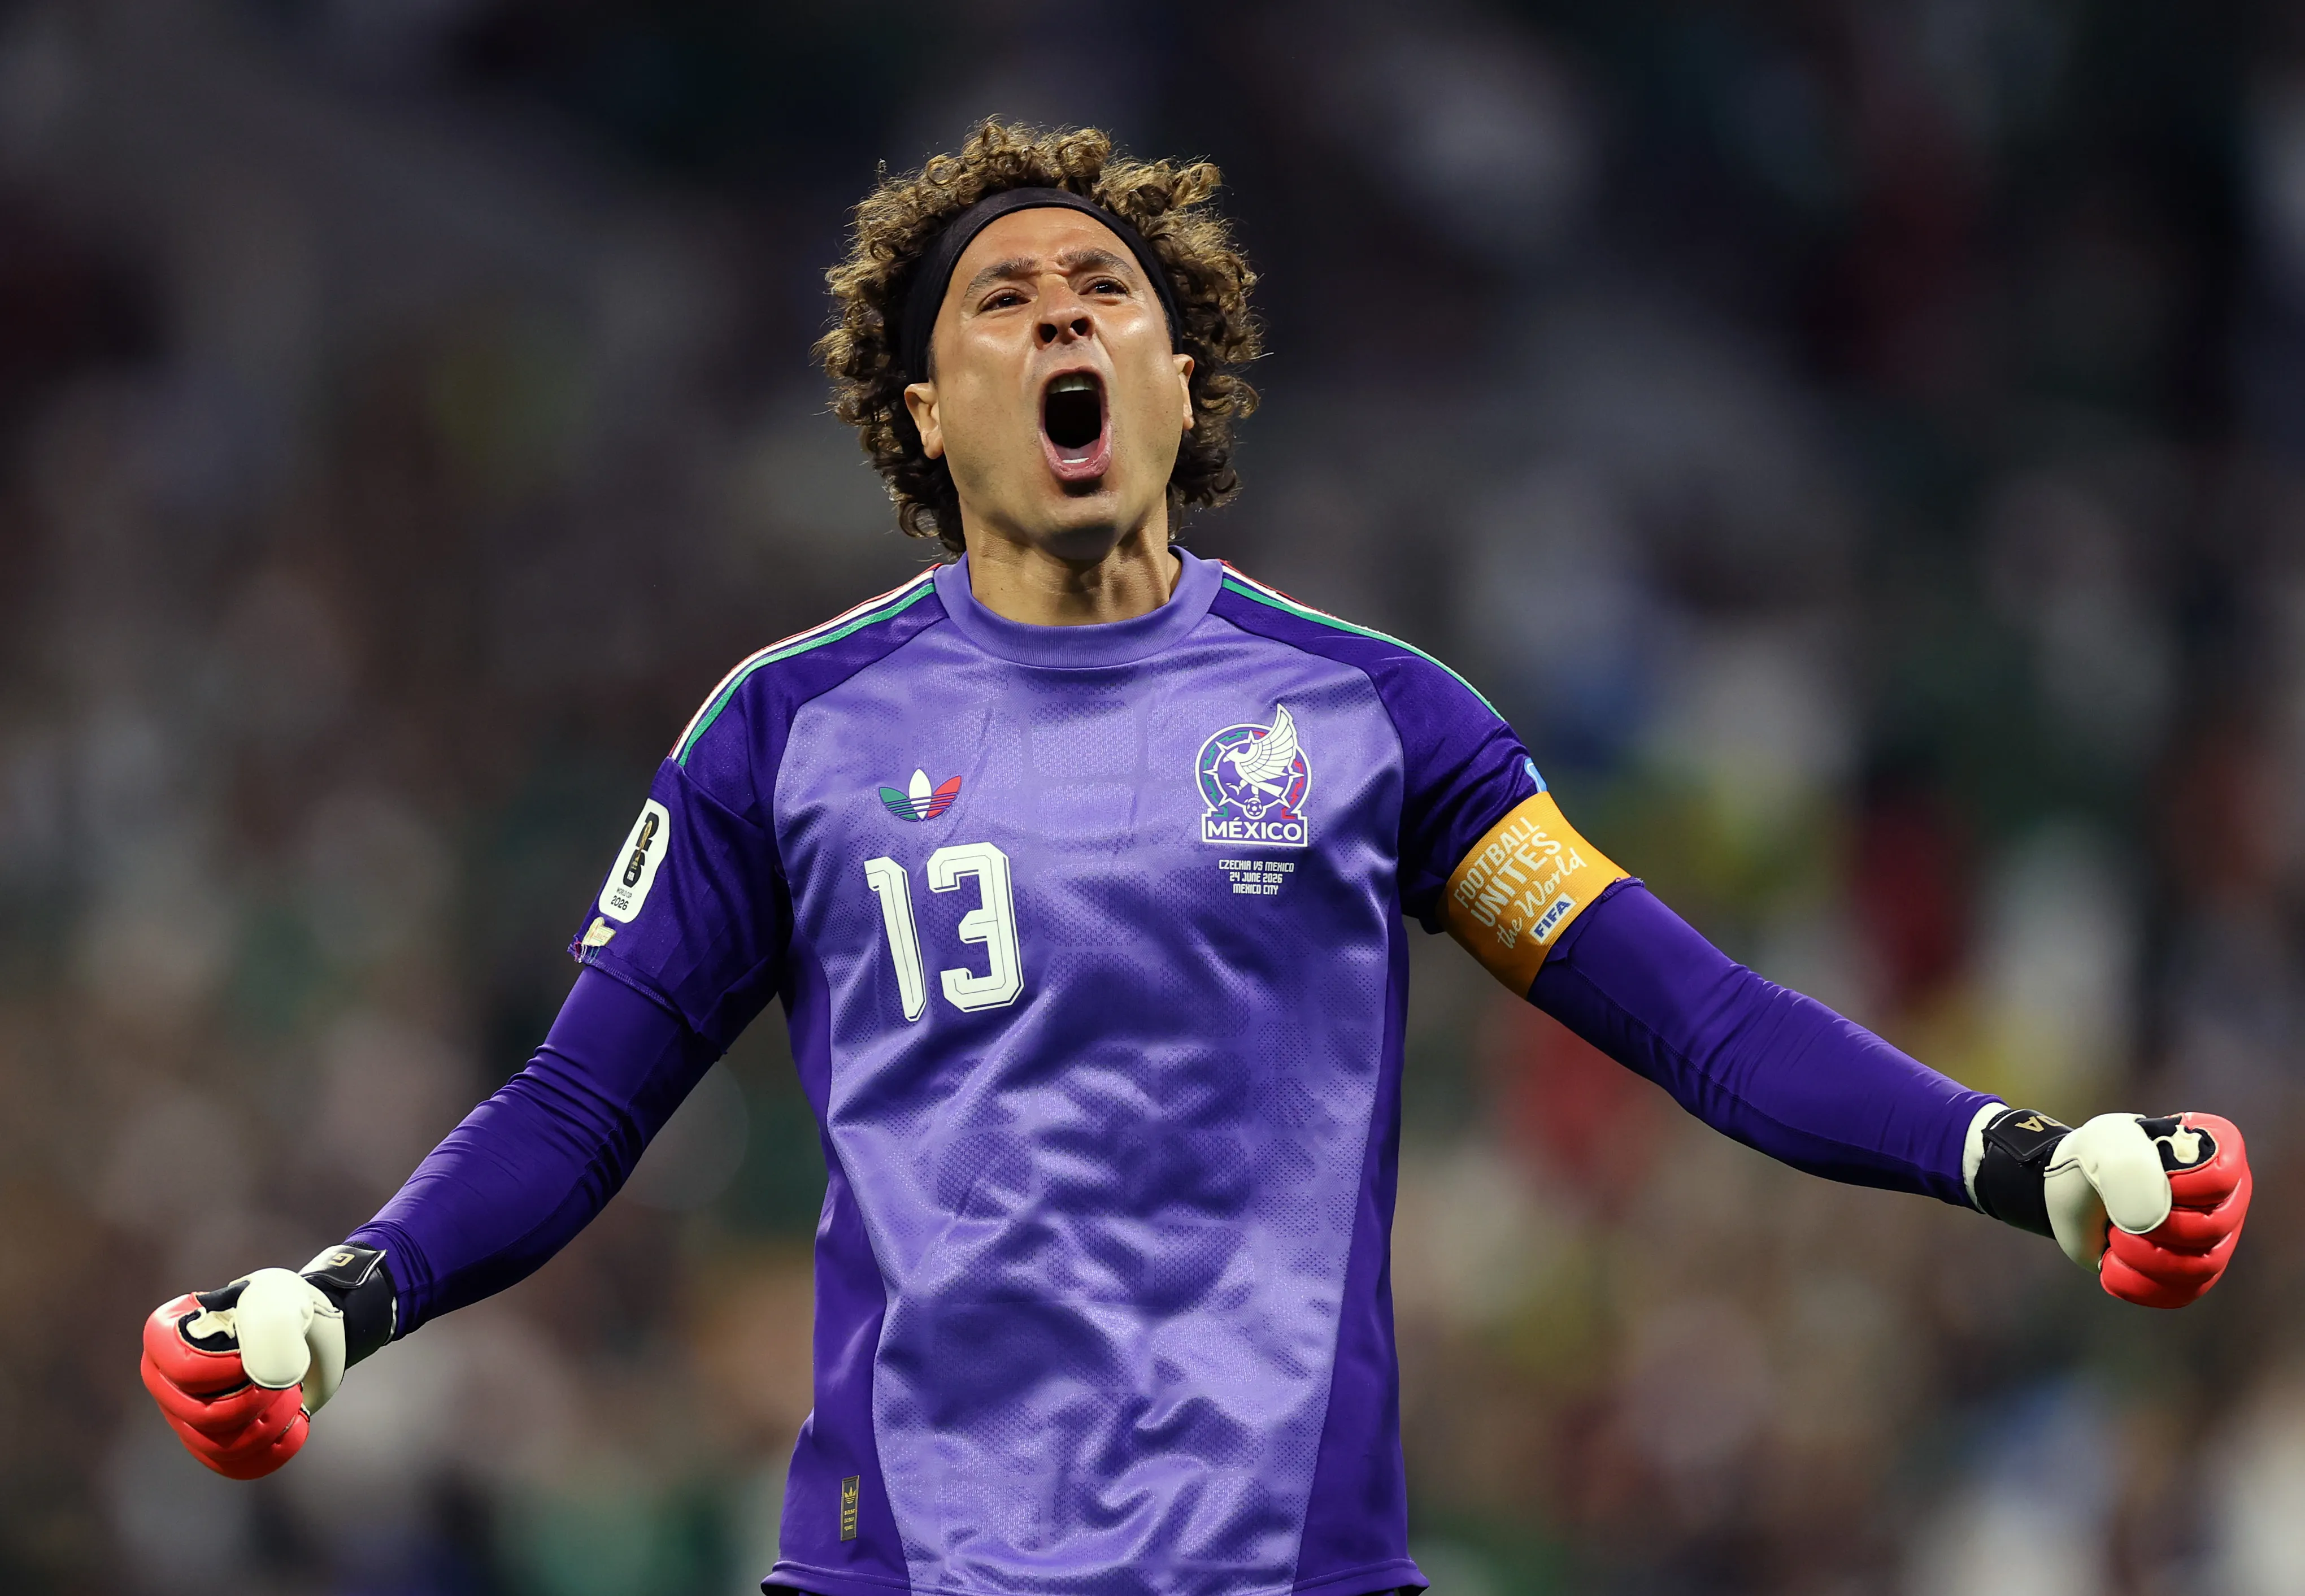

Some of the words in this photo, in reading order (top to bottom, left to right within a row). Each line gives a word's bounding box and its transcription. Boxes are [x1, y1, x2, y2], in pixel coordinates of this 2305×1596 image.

[1207, 817, 1302, 841] MÉXICO
[1219, 859, 1251, 871] CZECHIA
[1253, 861, 1263, 871] VS
[1265, 862, 1294, 872] MEXICO
[1229, 872, 1240, 881] 24
[1242, 872, 1261, 882] JUNE
[1263, 873, 1283, 883] 2026
[1454, 816, 1540, 909] FOOTBALL
[1233, 883, 1261, 894] MEXICO
[1263, 885, 1278, 895] CITY
[1471, 832, 1562, 927] UNITES
[611, 895, 629, 910] 2026
[1497, 916, 1523, 949] the
[1515, 847, 1587, 917] World
[864, 842, 1024, 1021] 13
[1534, 899, 1571, 938] FIFA
